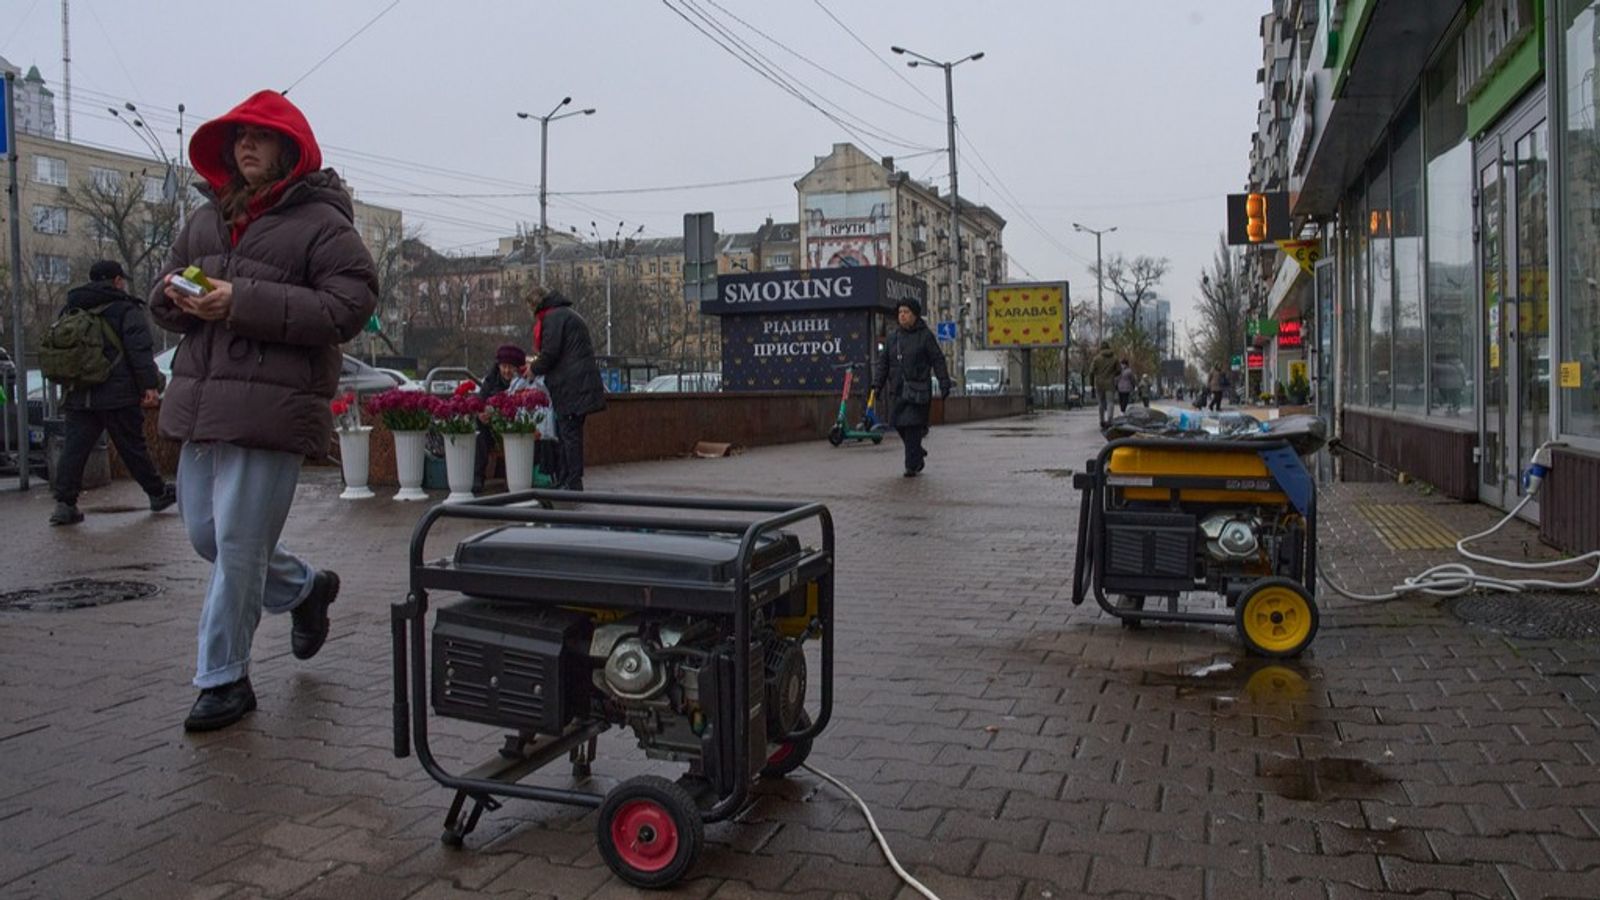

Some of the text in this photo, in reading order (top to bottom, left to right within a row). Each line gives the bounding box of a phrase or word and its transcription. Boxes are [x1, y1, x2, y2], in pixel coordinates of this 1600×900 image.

[724, 276, 853, 303] SMOKING
[994, 306, 1058, 318] KARABAS
[763, 319, 830, 336] РІДИНИ
[753, 338, 842, 357] ПРИСТРОЇ
